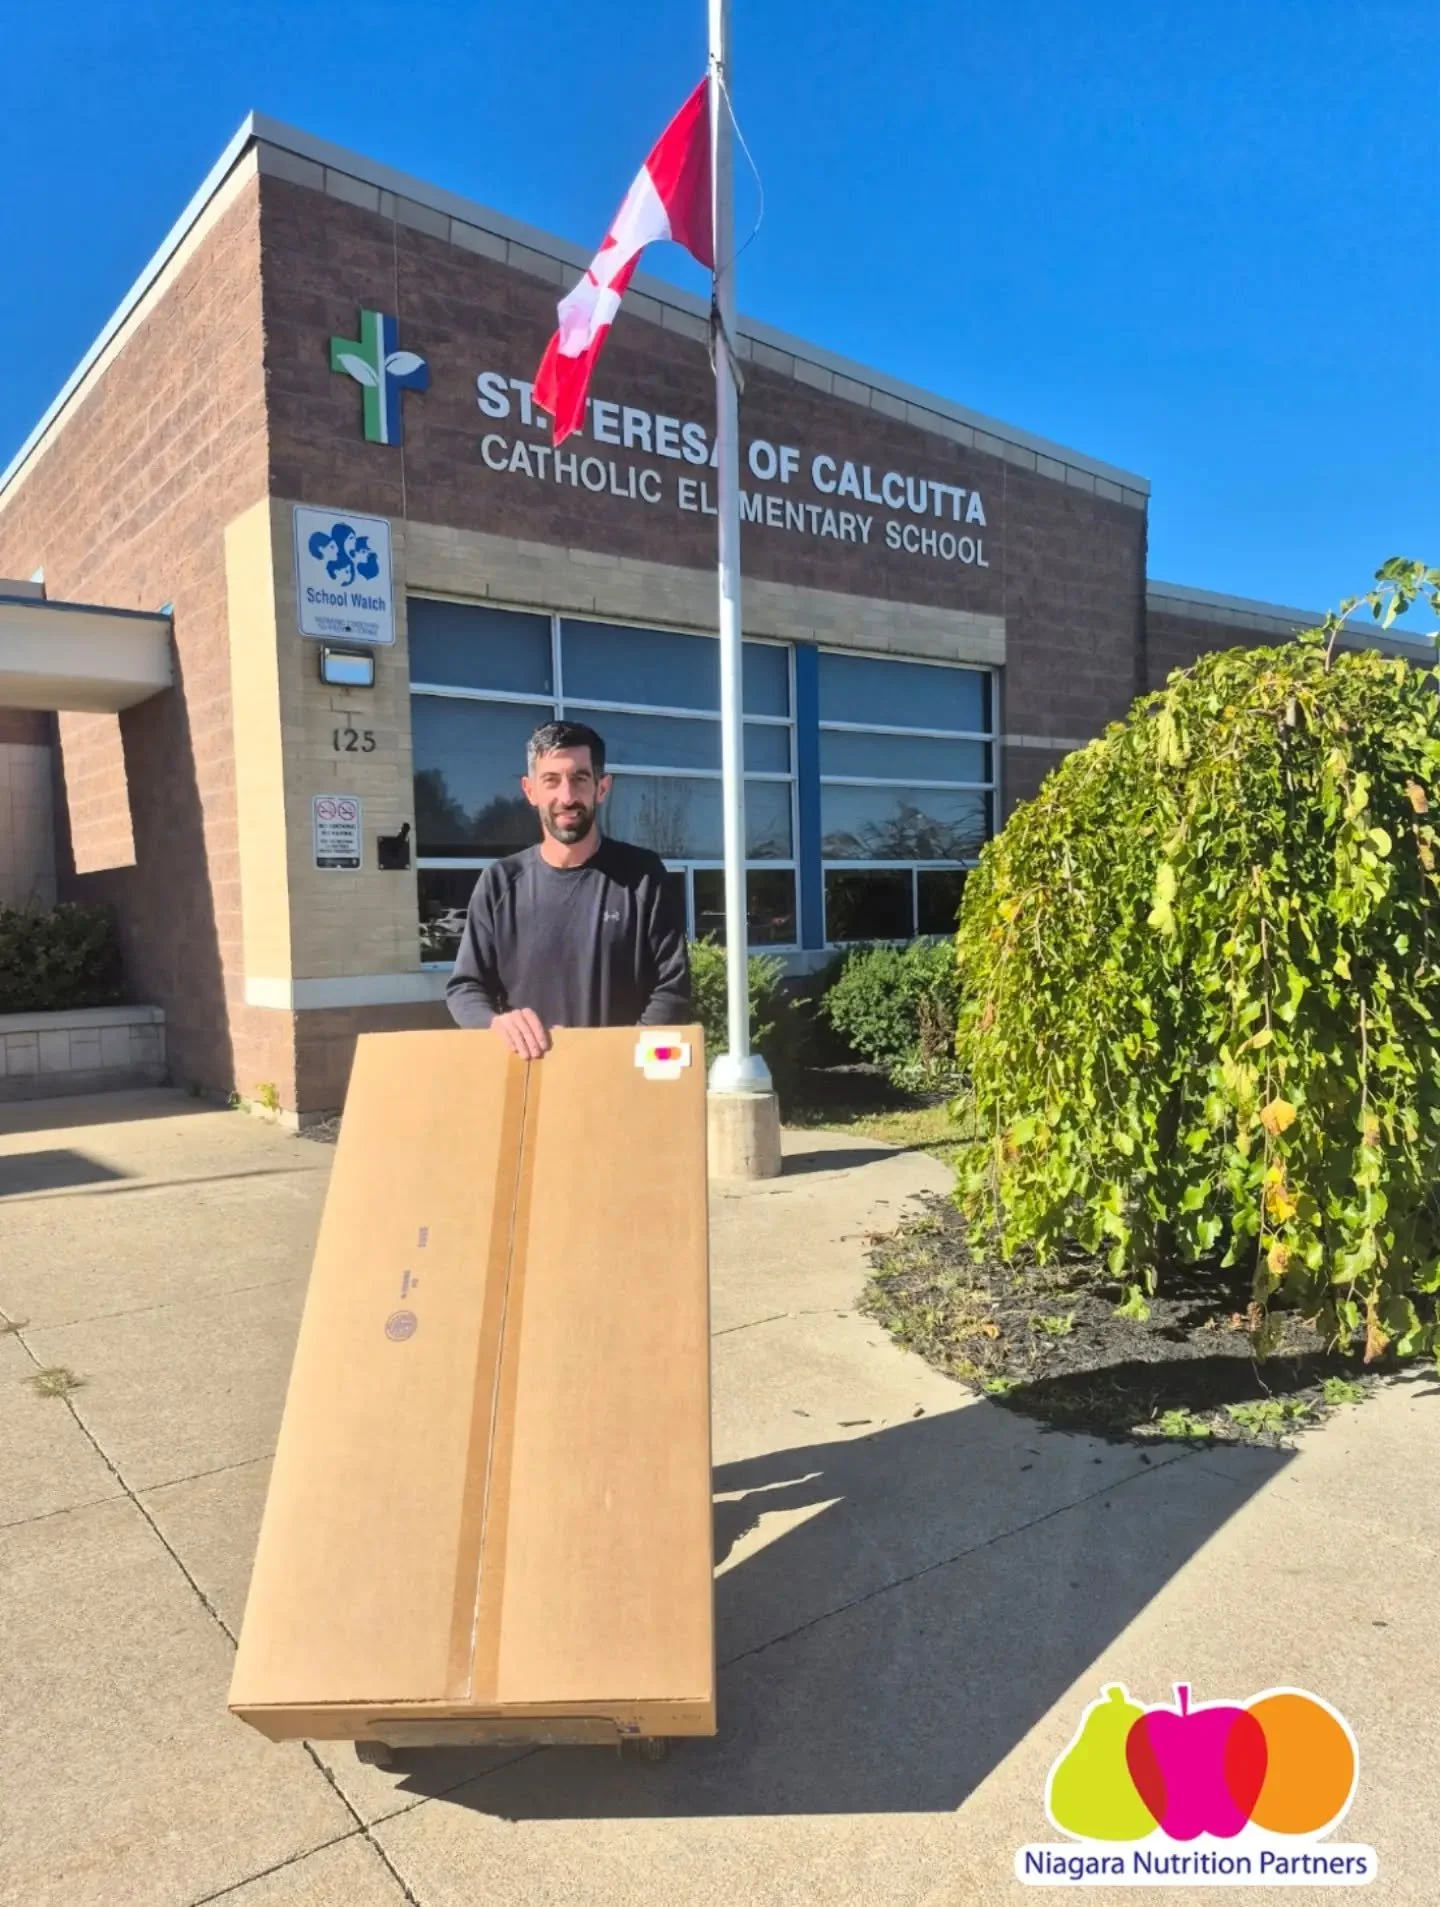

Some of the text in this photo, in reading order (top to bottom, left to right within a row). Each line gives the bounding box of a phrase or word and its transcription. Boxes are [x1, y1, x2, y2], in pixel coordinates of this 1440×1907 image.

[476, 371, 987, 527] ST. ERES OF CALCUTTA
[480, 433, 990, 568] CATHOLIC ELMENTARY SCHOOL
[306, 587, 386, 612] School Watch
[333, 728, 377, 753] 125
